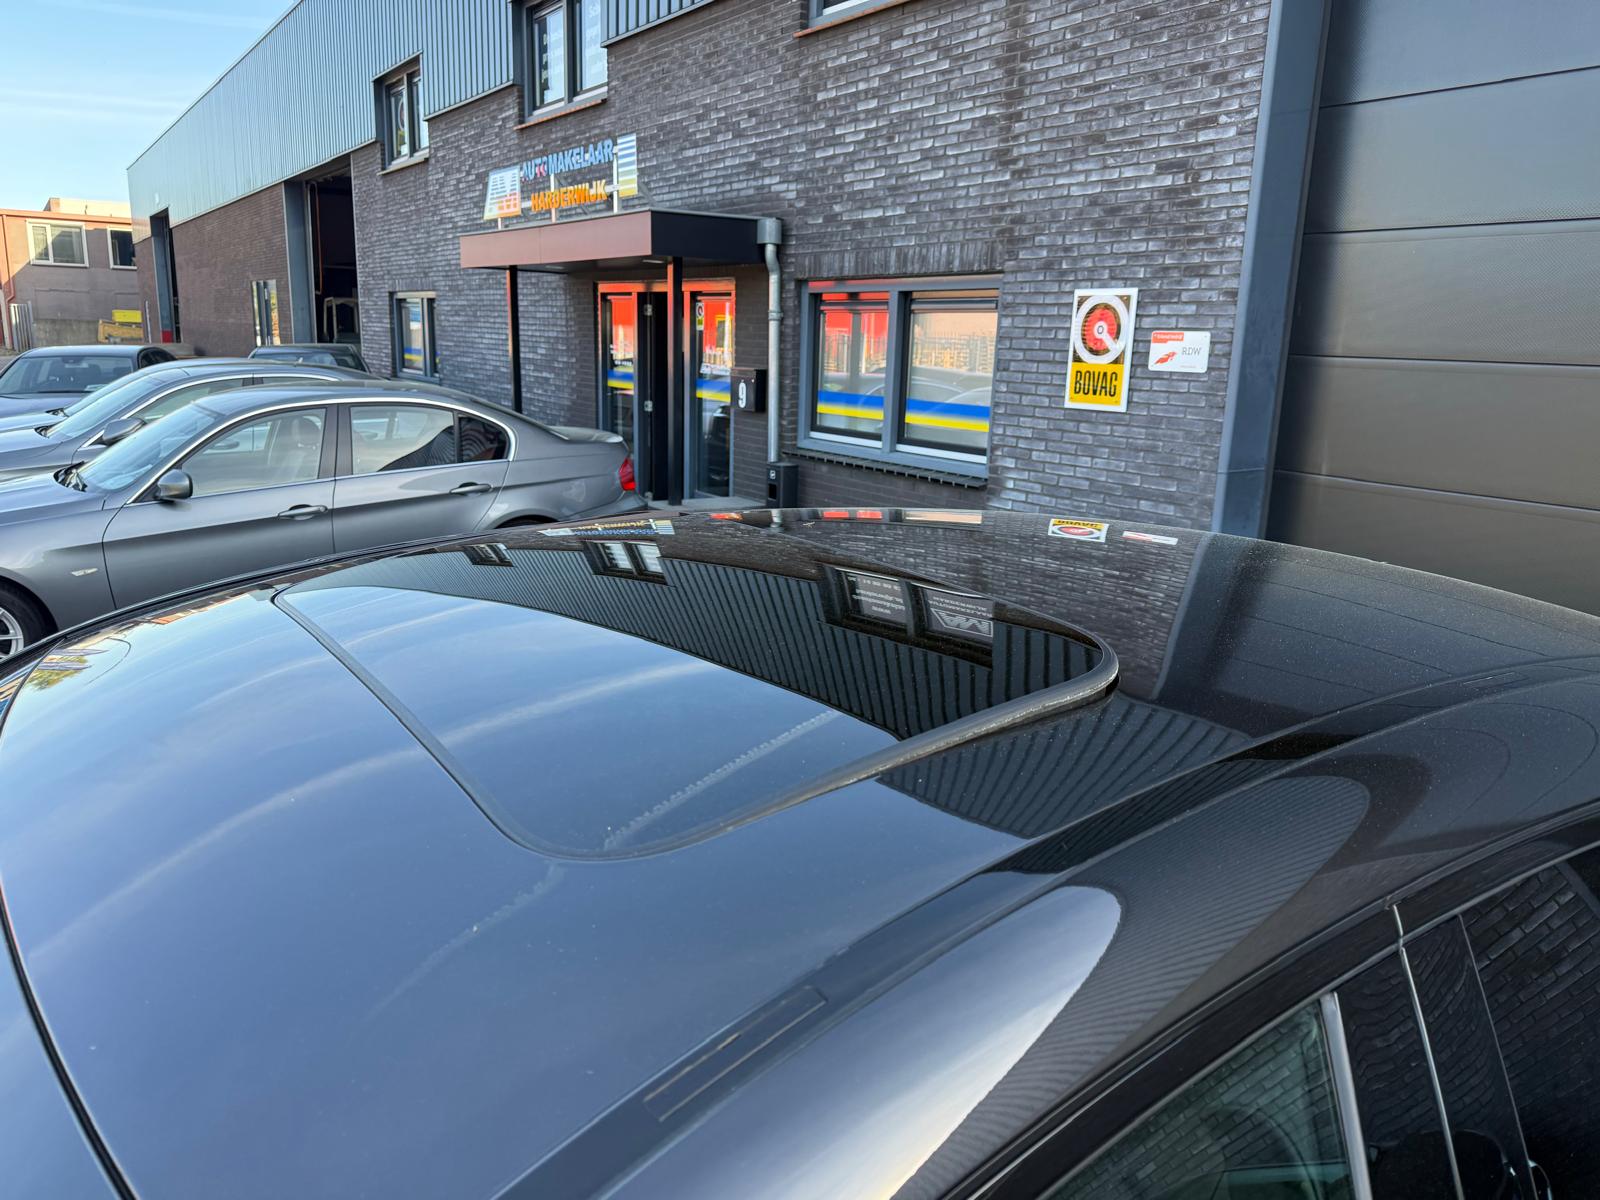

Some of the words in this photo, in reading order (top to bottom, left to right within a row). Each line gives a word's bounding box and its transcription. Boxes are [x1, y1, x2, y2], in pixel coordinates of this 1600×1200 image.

[520, 139, 614, 181] AUTOMAKELAAR
[531, 179, 608, 212] HARDERWIJK
[1181, 346, 1202, 356] RDW
[738, 382, 747, 409] 9
[1073, 370, 1119, 398] BOVAG
